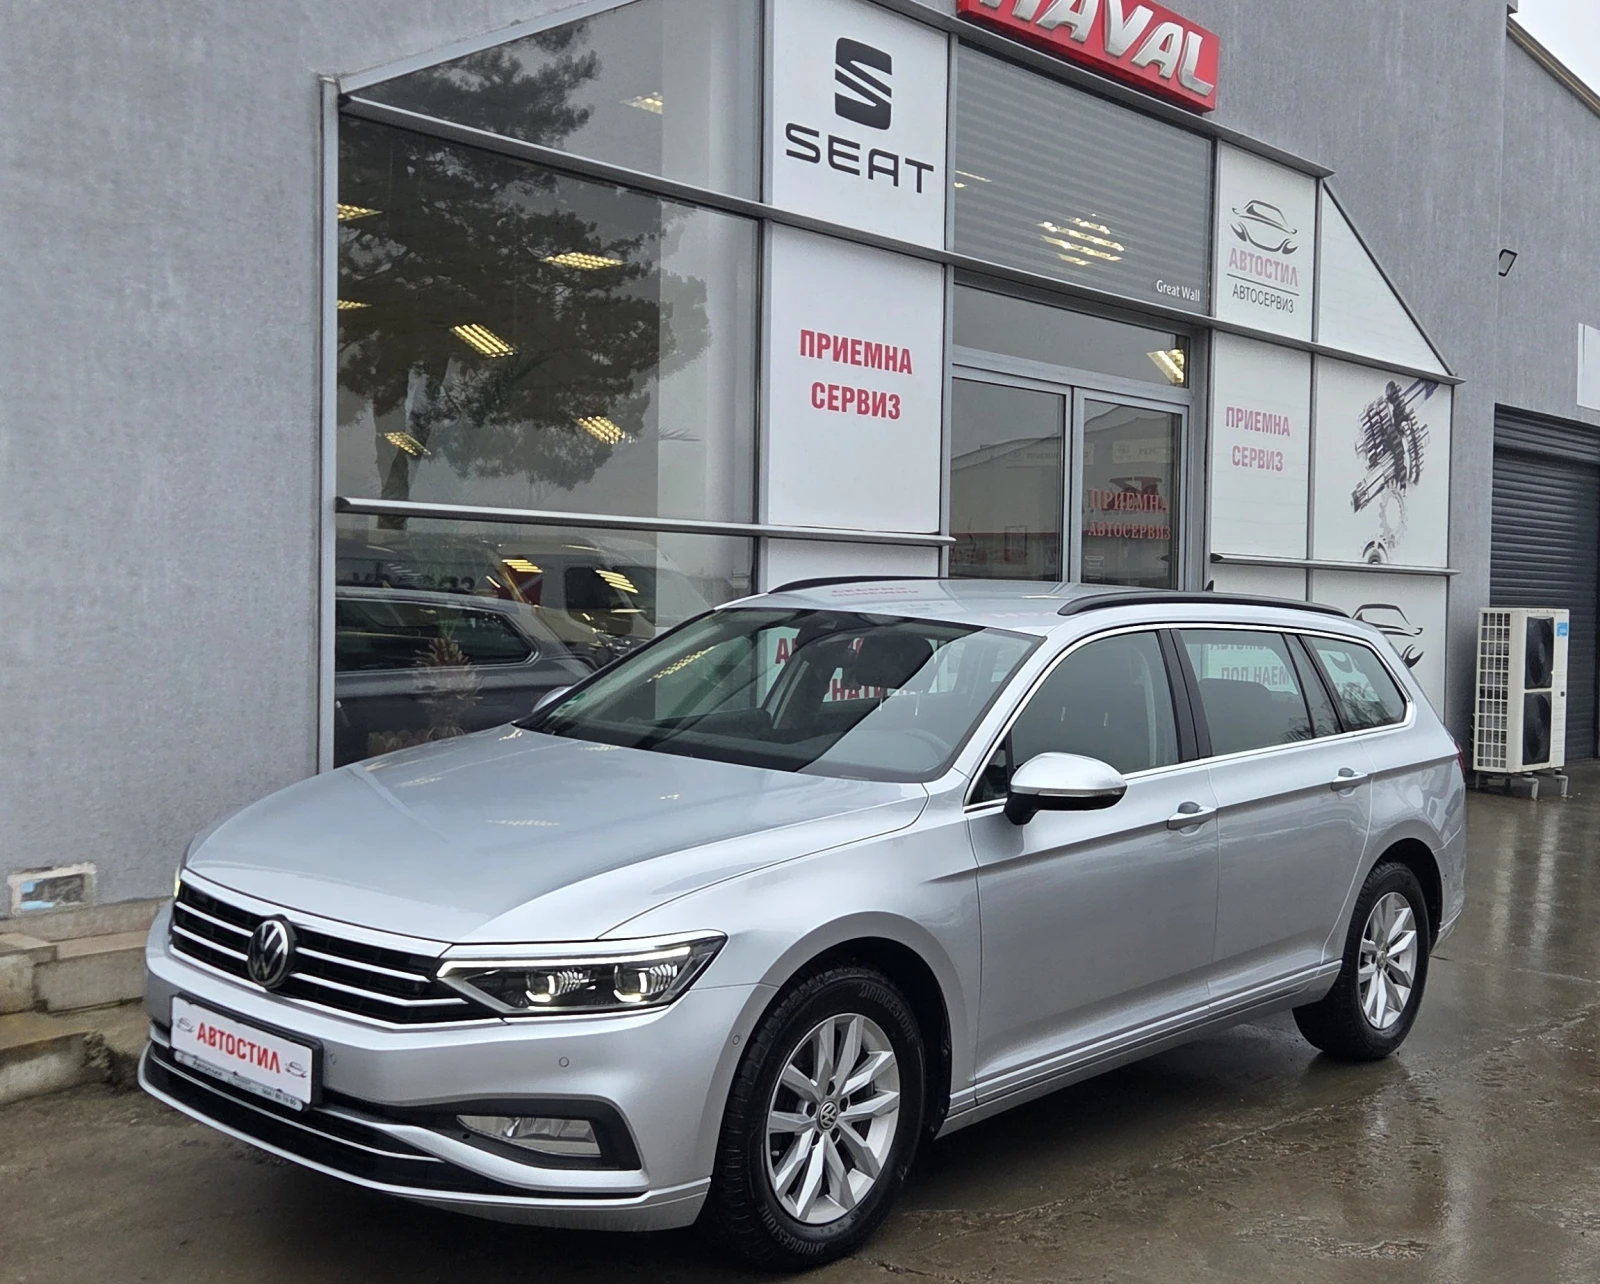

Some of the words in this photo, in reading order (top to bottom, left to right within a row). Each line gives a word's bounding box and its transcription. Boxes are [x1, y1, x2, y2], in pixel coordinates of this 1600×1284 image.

[977, 0, 1214, 97] AVAL
[785, 122, 935, 194] SEAT
[1228, 247, 1299, 288] АВТОСТИЛ
[1156, 279, 1180, 298] Great
[1181, 285, 1200, 302] Wall
[1231, 283, 1294, 314] АВТОСЕРВИЗ
[800, 328, 913, 375] ПРИЕМНА
[811, 381, 901, 420] СЕРВИЗ
[1225, 406, 1291, 437] ПРИЕМНА
[1231, 445, 1284, 472] СЕРВИЗ
[1088, 487, 1170, 514] ПРИЕМНА
[1087, 520, 1171, 541] АВТОСЕРВИЗ
[196, 1021, 281, 1074] АВТОСТИЛ
